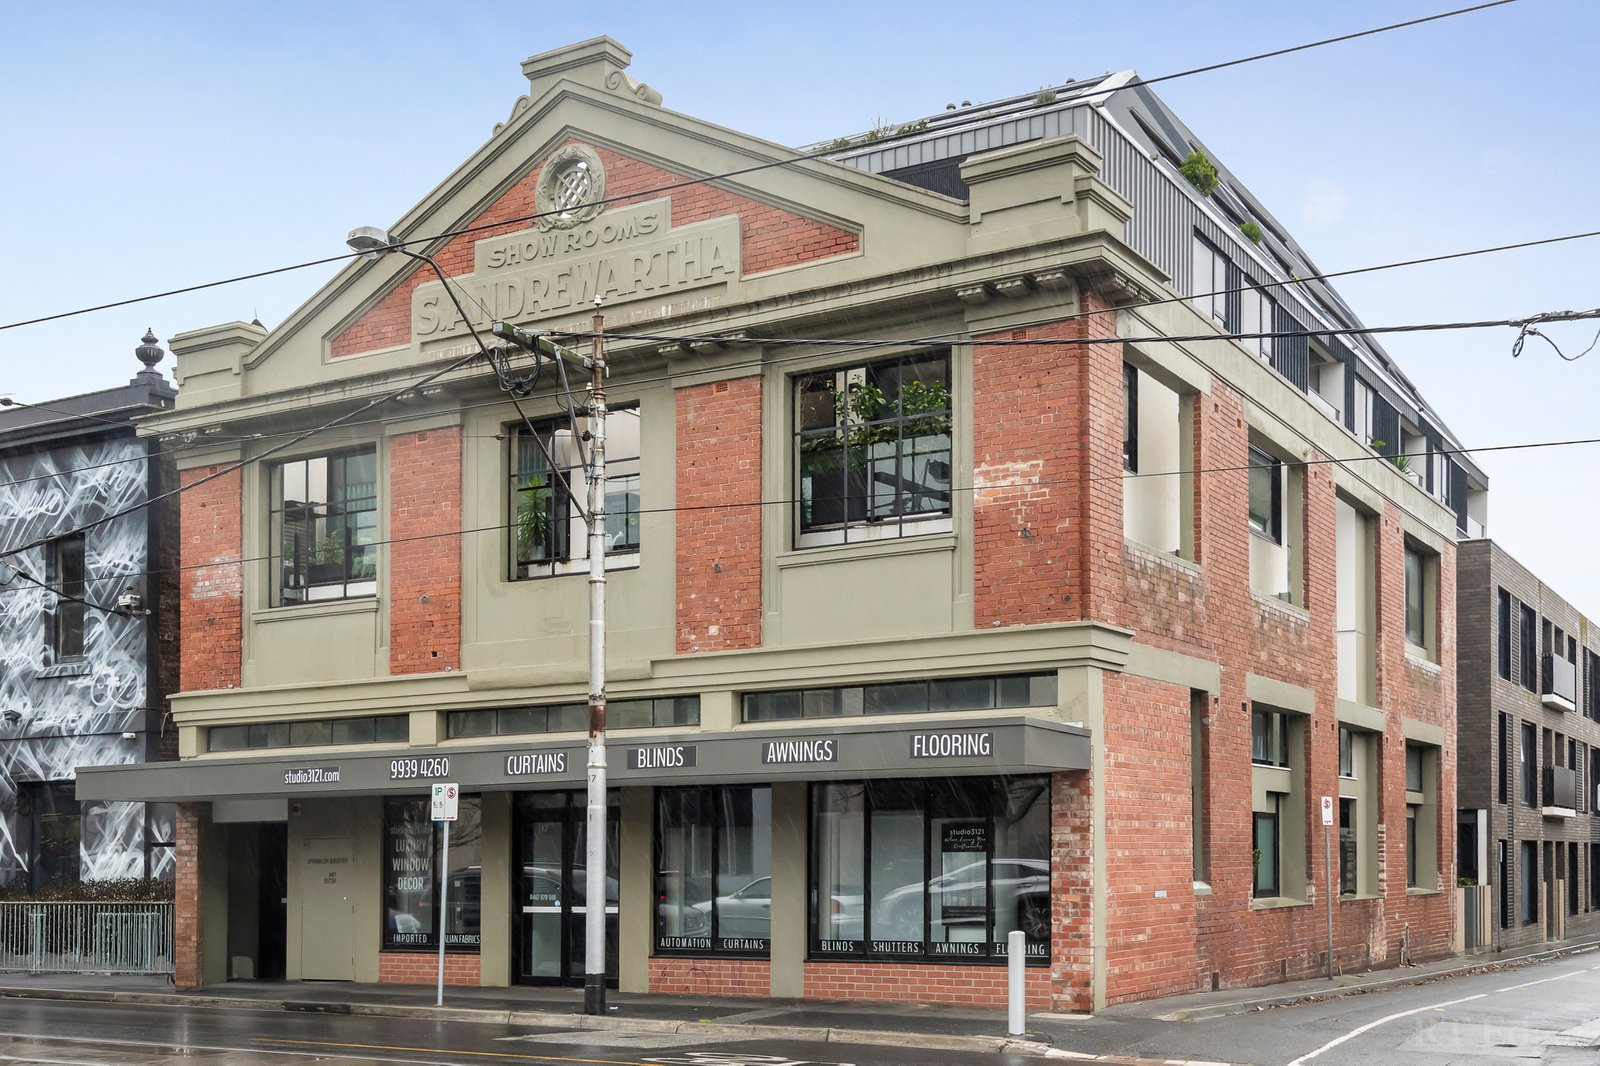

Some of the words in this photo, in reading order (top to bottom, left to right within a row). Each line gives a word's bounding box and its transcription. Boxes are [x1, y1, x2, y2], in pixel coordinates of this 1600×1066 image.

[487, 235, 557, 269] SHOW
[563, 213, 660, 254] ROOMS
[766, 740, 833, 763] AWNINGS
[913, 734, 990, 757] FLOORING
[506, 753, 565, 775] CURTAINS
[637, 747, 684, 769] BLINDS
[390, 759, 417, 778] 9939
[420, 757, 449, 777] 4260
[284, 768, 339, 784] studio3121.com
[949, 828, 985, 836] studio3121
[396, 839, 426, 852] LUXURY
[392, 857, 429, 872] WINDOW
[398, 876, 424, 890] DECOR
[393, 933, 428, 944] IMPORTED
[458, 935, 480, 945] FABRICS
[660, 937, 711, 948] AUTOMATION
[723, 938, 764, 949] CURTAINS
[821, 941, 854, 952] BLINDS
[872, 942, 919, 953] SHUTTERS
[935, 943, 979, 954] AWNINGS
